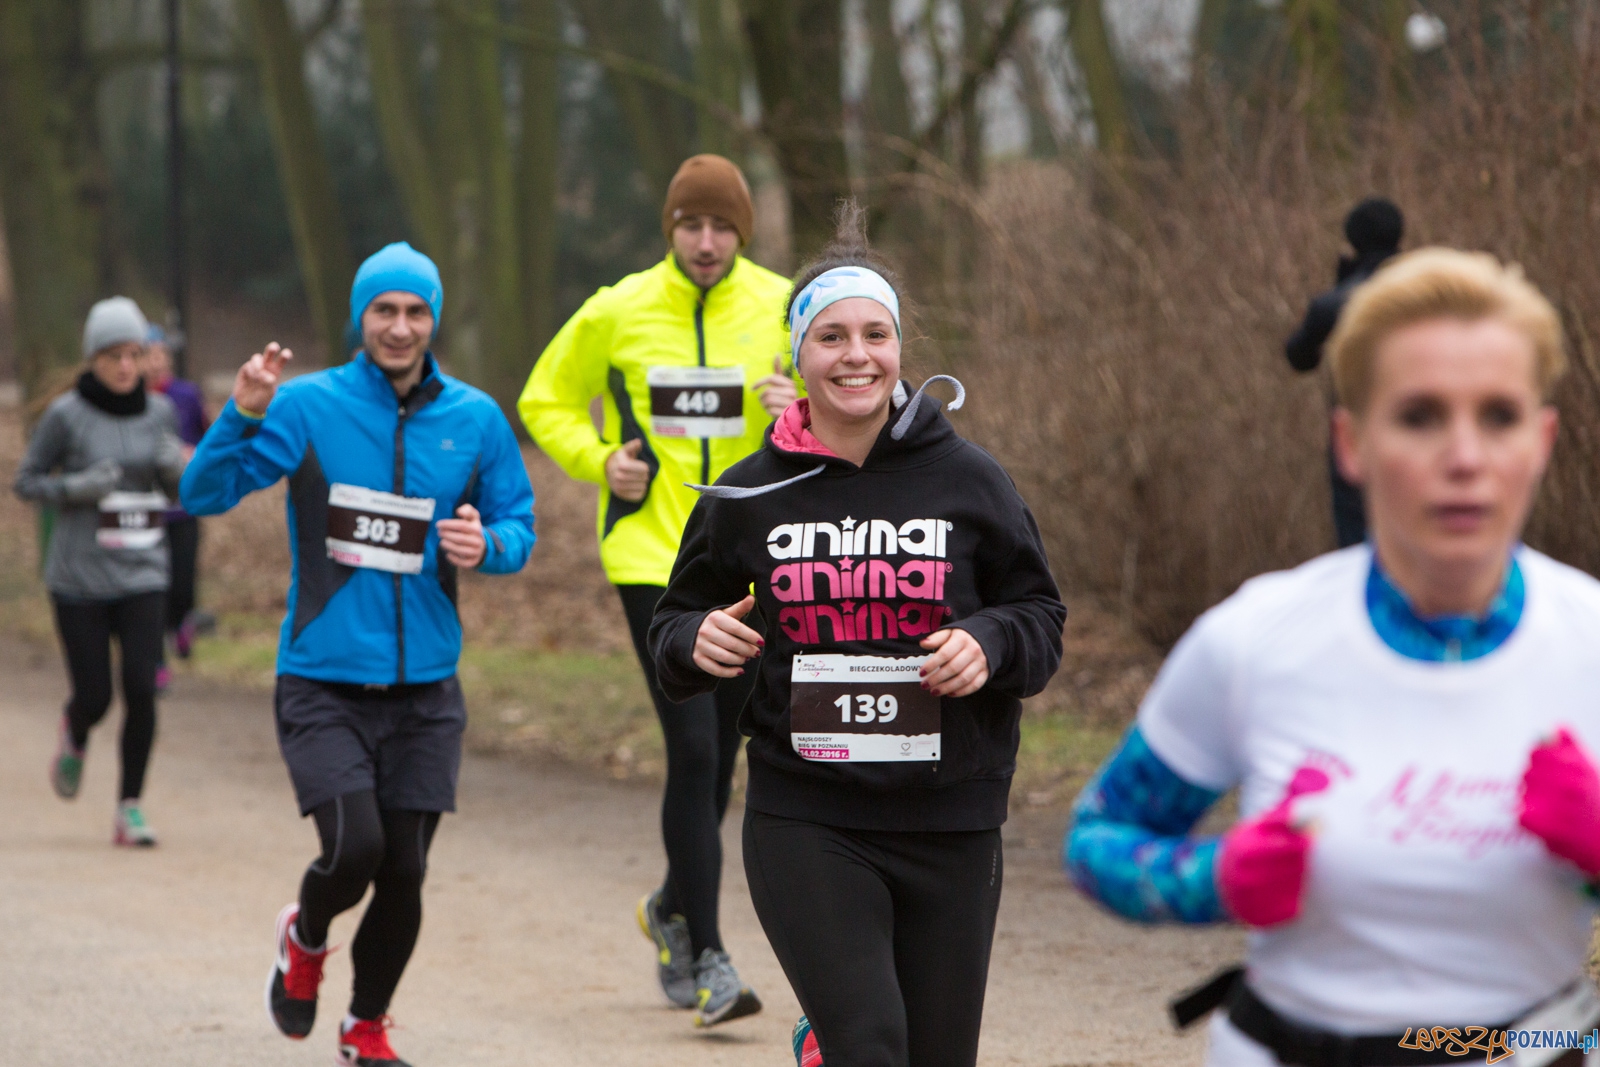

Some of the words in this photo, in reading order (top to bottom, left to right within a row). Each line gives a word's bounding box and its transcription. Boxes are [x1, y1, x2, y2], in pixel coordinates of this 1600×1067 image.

[673, 390, 720, 414] 449
[352, 515, 401, 545] 303
[833, 693, 899, 723] 139
[800, 749, 841, 758] 14.02.2016
